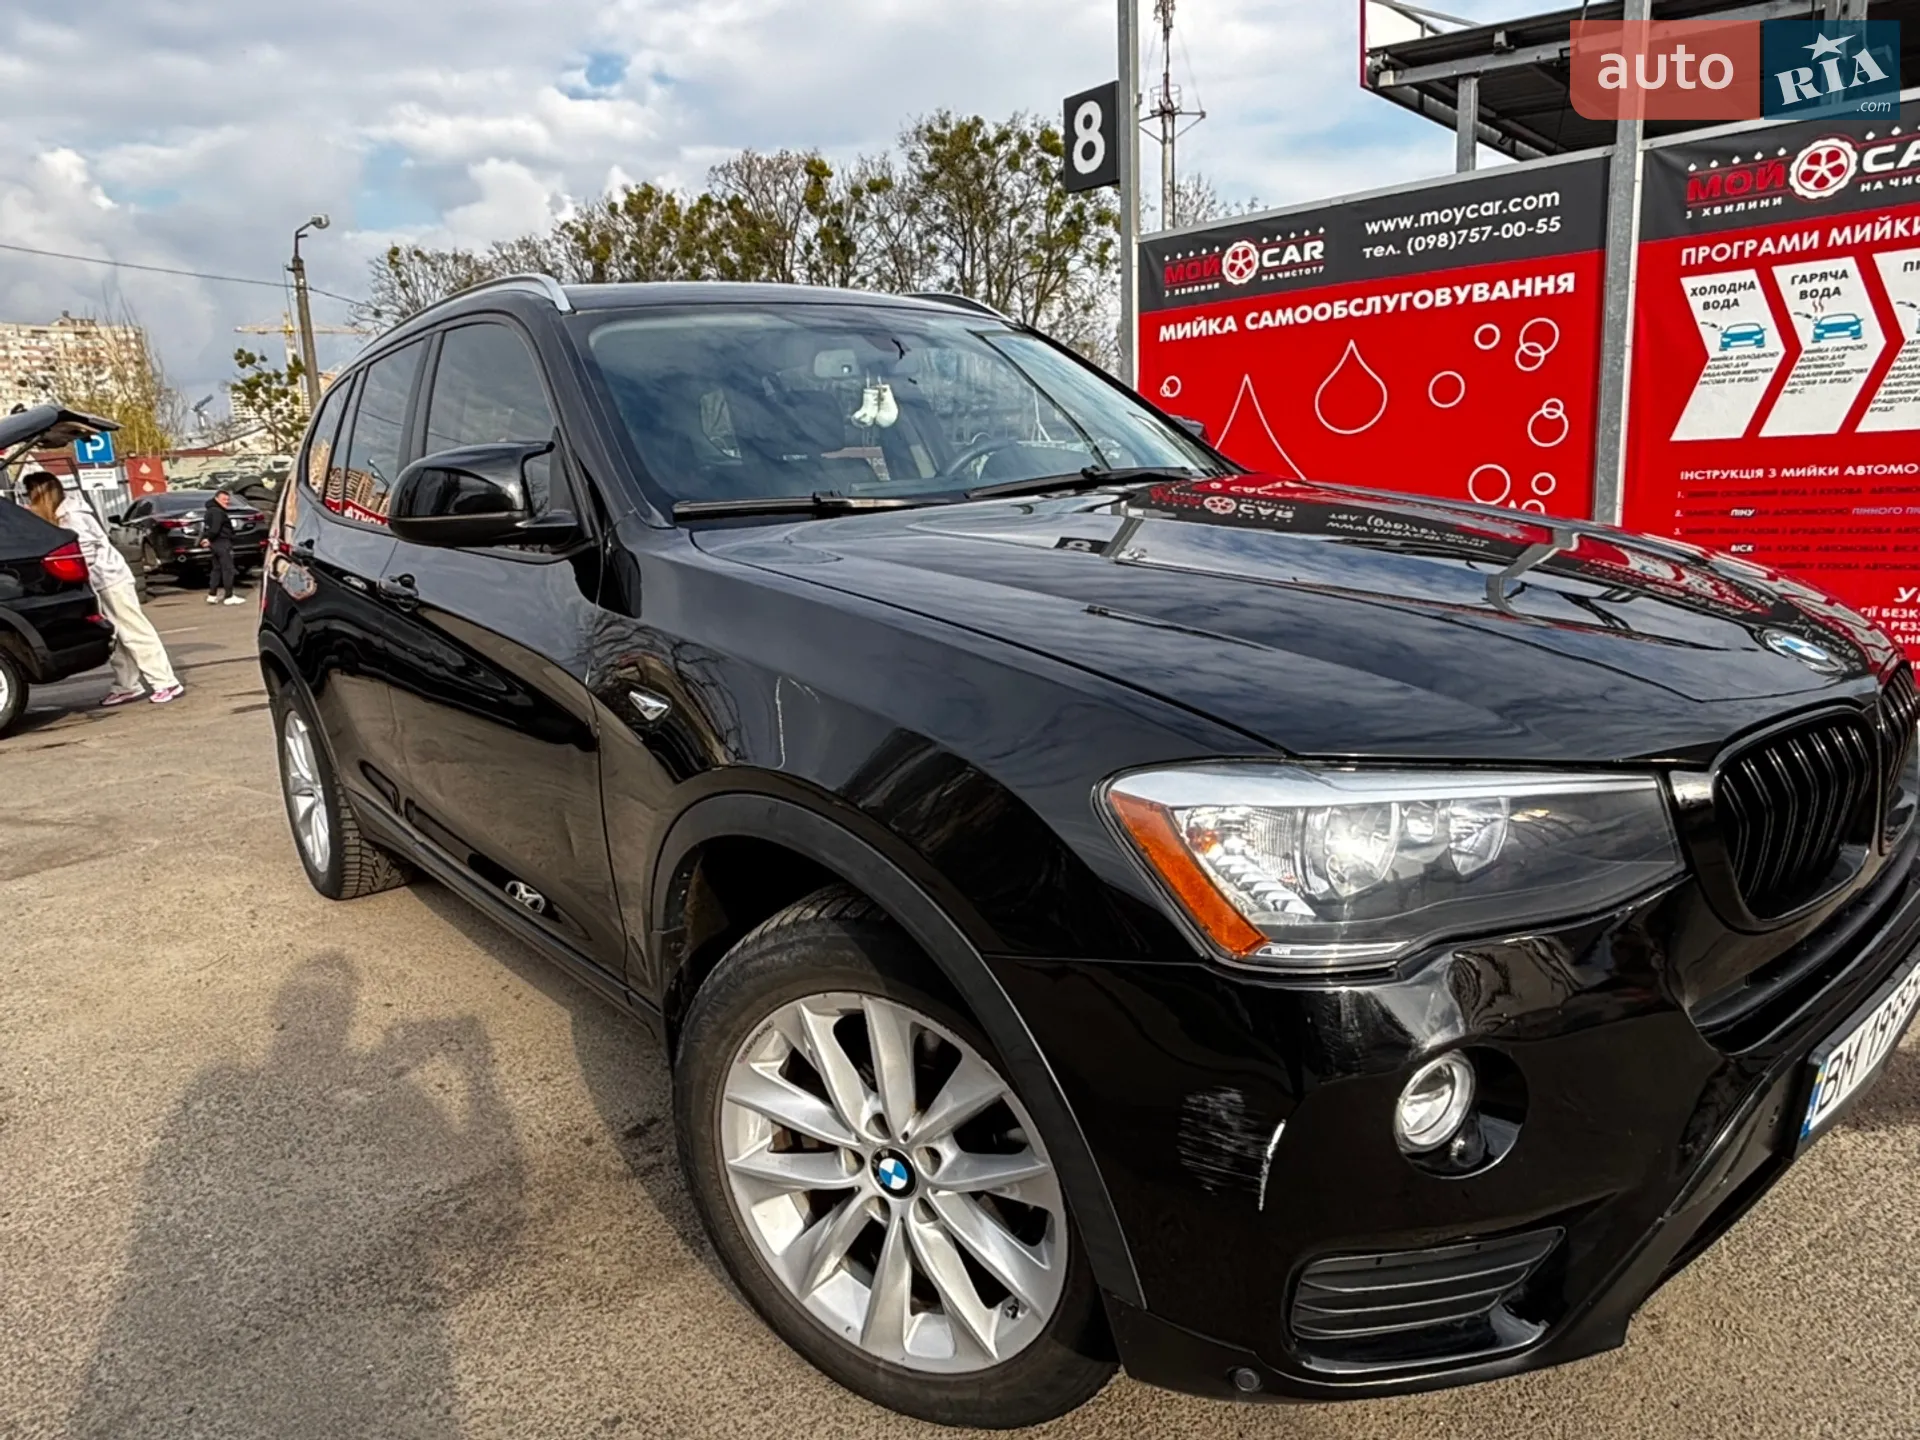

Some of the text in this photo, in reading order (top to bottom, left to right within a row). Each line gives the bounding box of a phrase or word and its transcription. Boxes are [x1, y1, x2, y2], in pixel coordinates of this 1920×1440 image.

[1072, 100, 1105, 175] 8
[1702, 196, 1783, 217] ХВИЛИНИ
[1860, 181, 1884, 192] НА
[1365, 191, 1560, 236] www.moycar.com
[1363, 215, 1562, 259] тел. (098)757-00-55
[1680, 231, 1819, 267] ПРОГРАМИ
[1262, 240, 1324, 268] CAR
[1690, 281, 1757, 297] ХОЛОДНА
[1790, 269, 1849, 286] ГАРЯЧА
[1159, 272, 1576, 342] МИЙКА САМООБСЛУГОВУВАННЯ
[1702, 298, 1740, 311] ВОДА
[1799, 286, 1842, 300] ВОДА
[85, 435, 105, 460] P
[1680, 468, 1764, 480] ІНСТРУКЦІЯ
[1780, 464, 1839, 478] МИЙКИ
